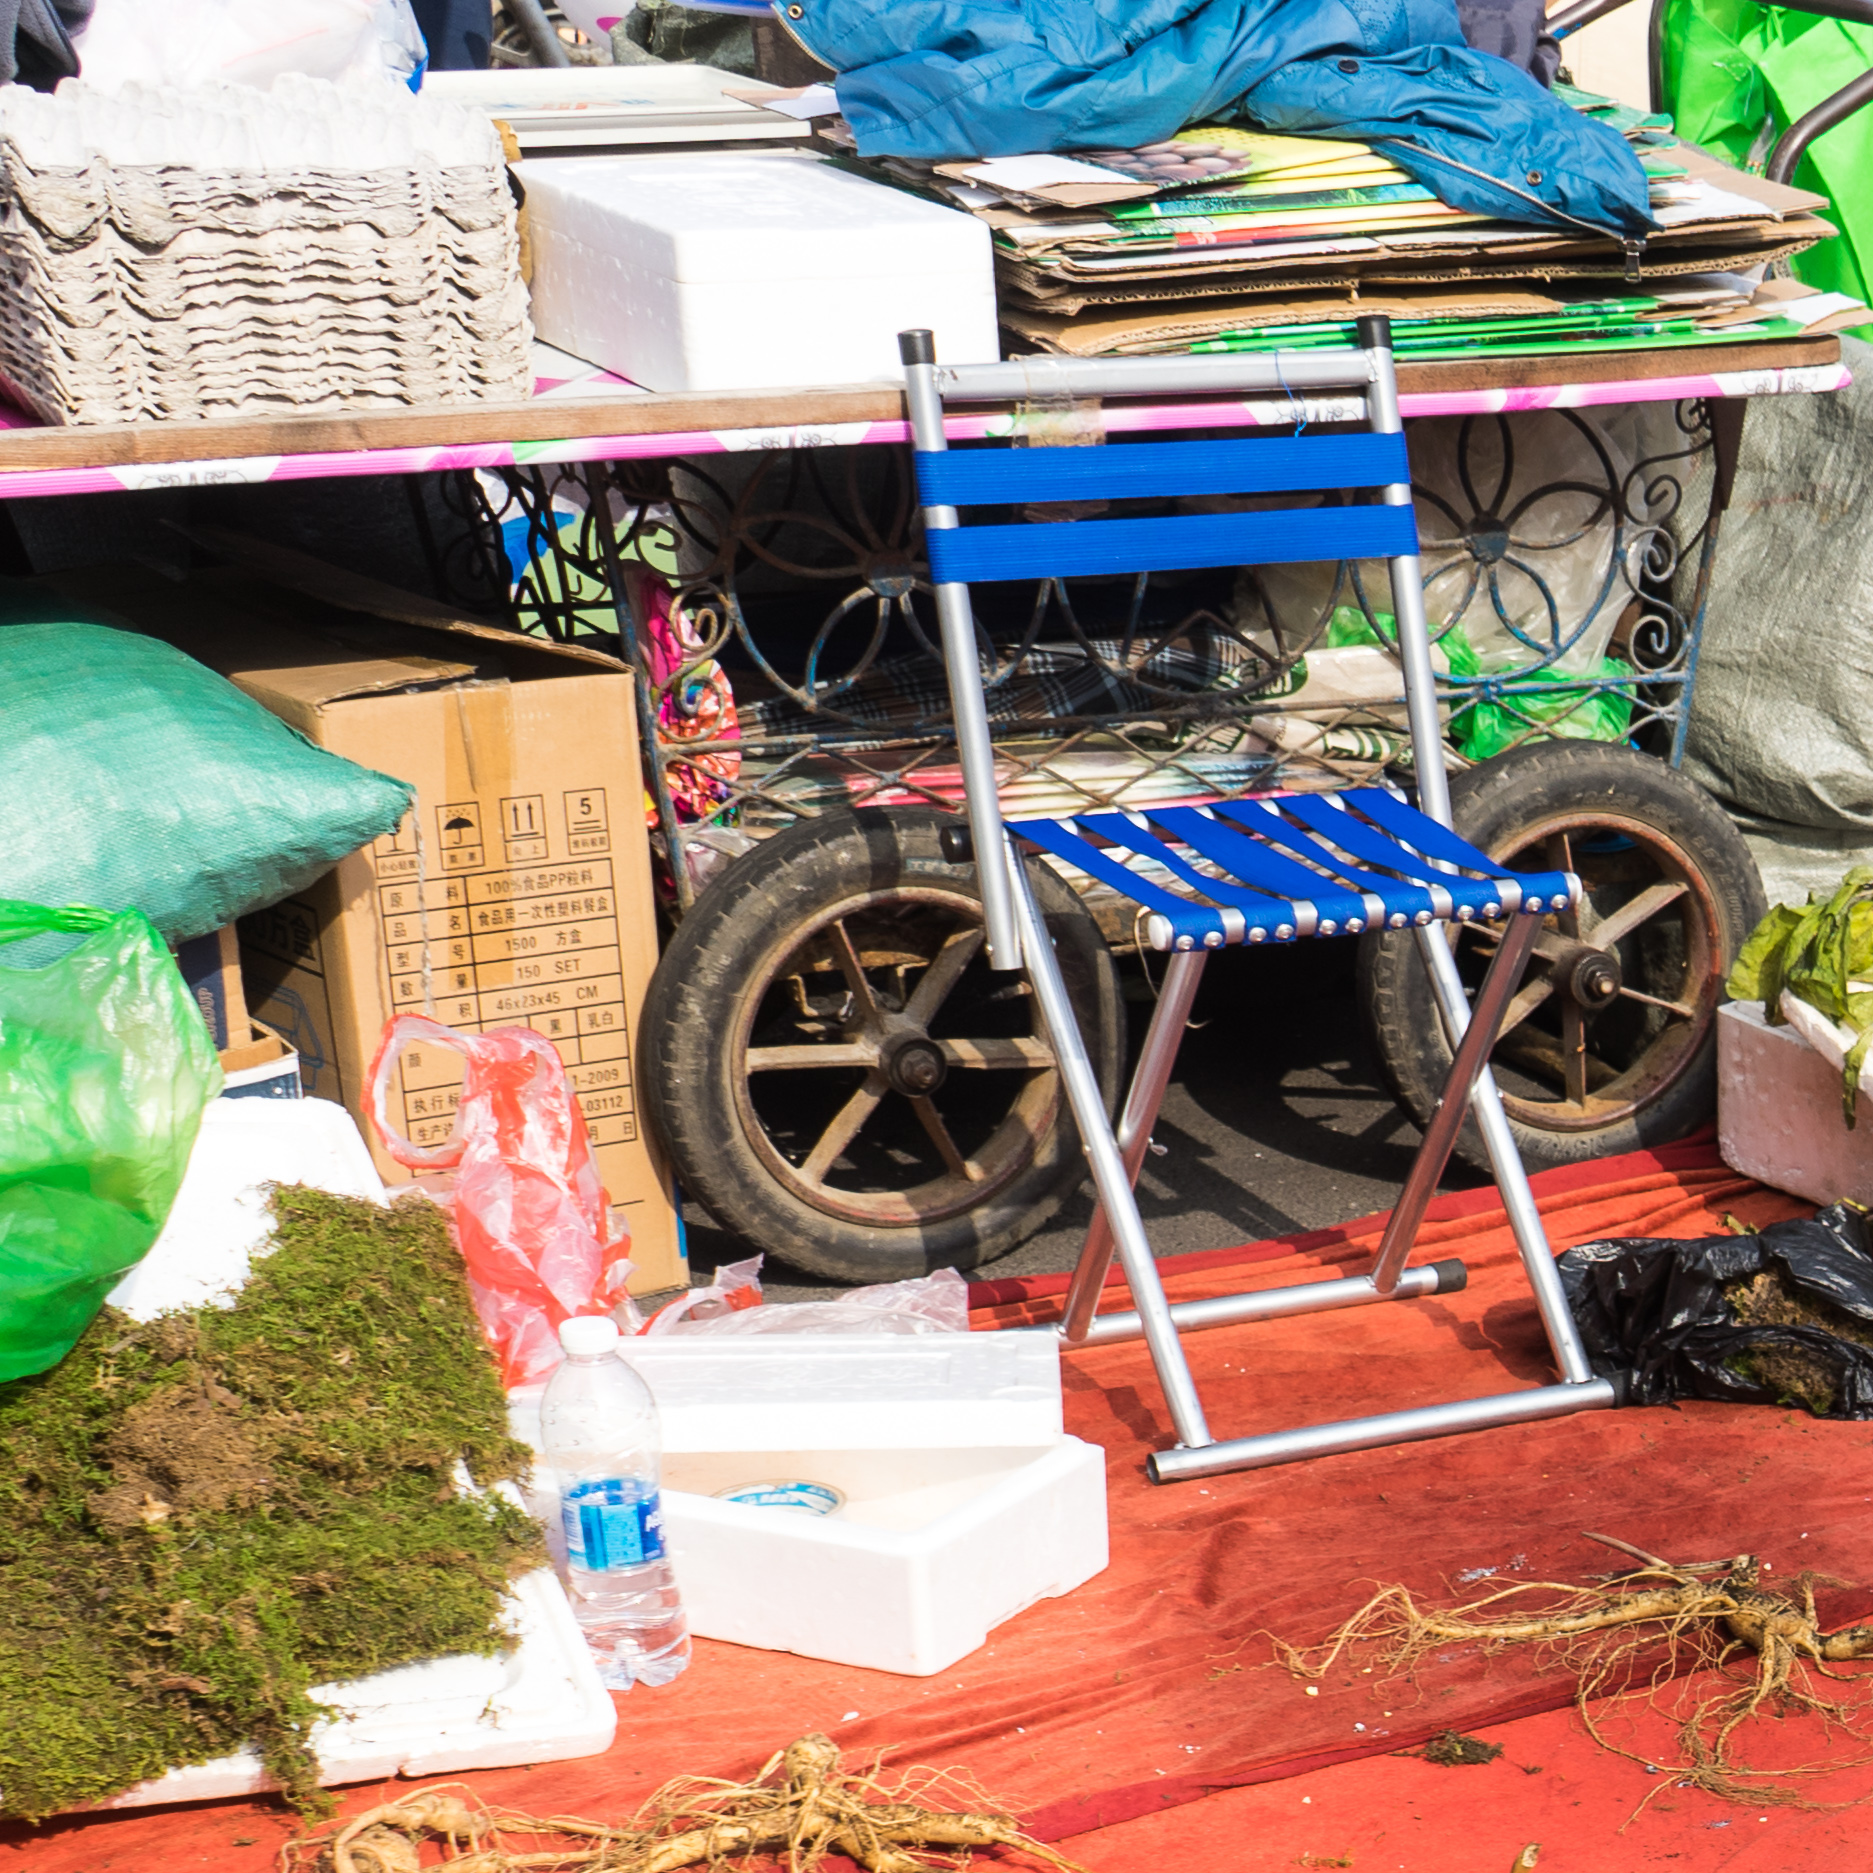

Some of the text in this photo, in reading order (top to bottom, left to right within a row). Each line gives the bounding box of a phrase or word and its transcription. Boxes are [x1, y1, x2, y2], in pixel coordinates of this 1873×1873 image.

[580, 797, 592, 815] 5
[504, 935, 537, 952] 1500
[516, 964, 541, 980] 150
[554, 959, 582, 975] SET
[576, 985, 599, 1001] CM
[572, 1068, 620, 1087] 1-2009
[413, 1091, 461, 1113] 执行标
